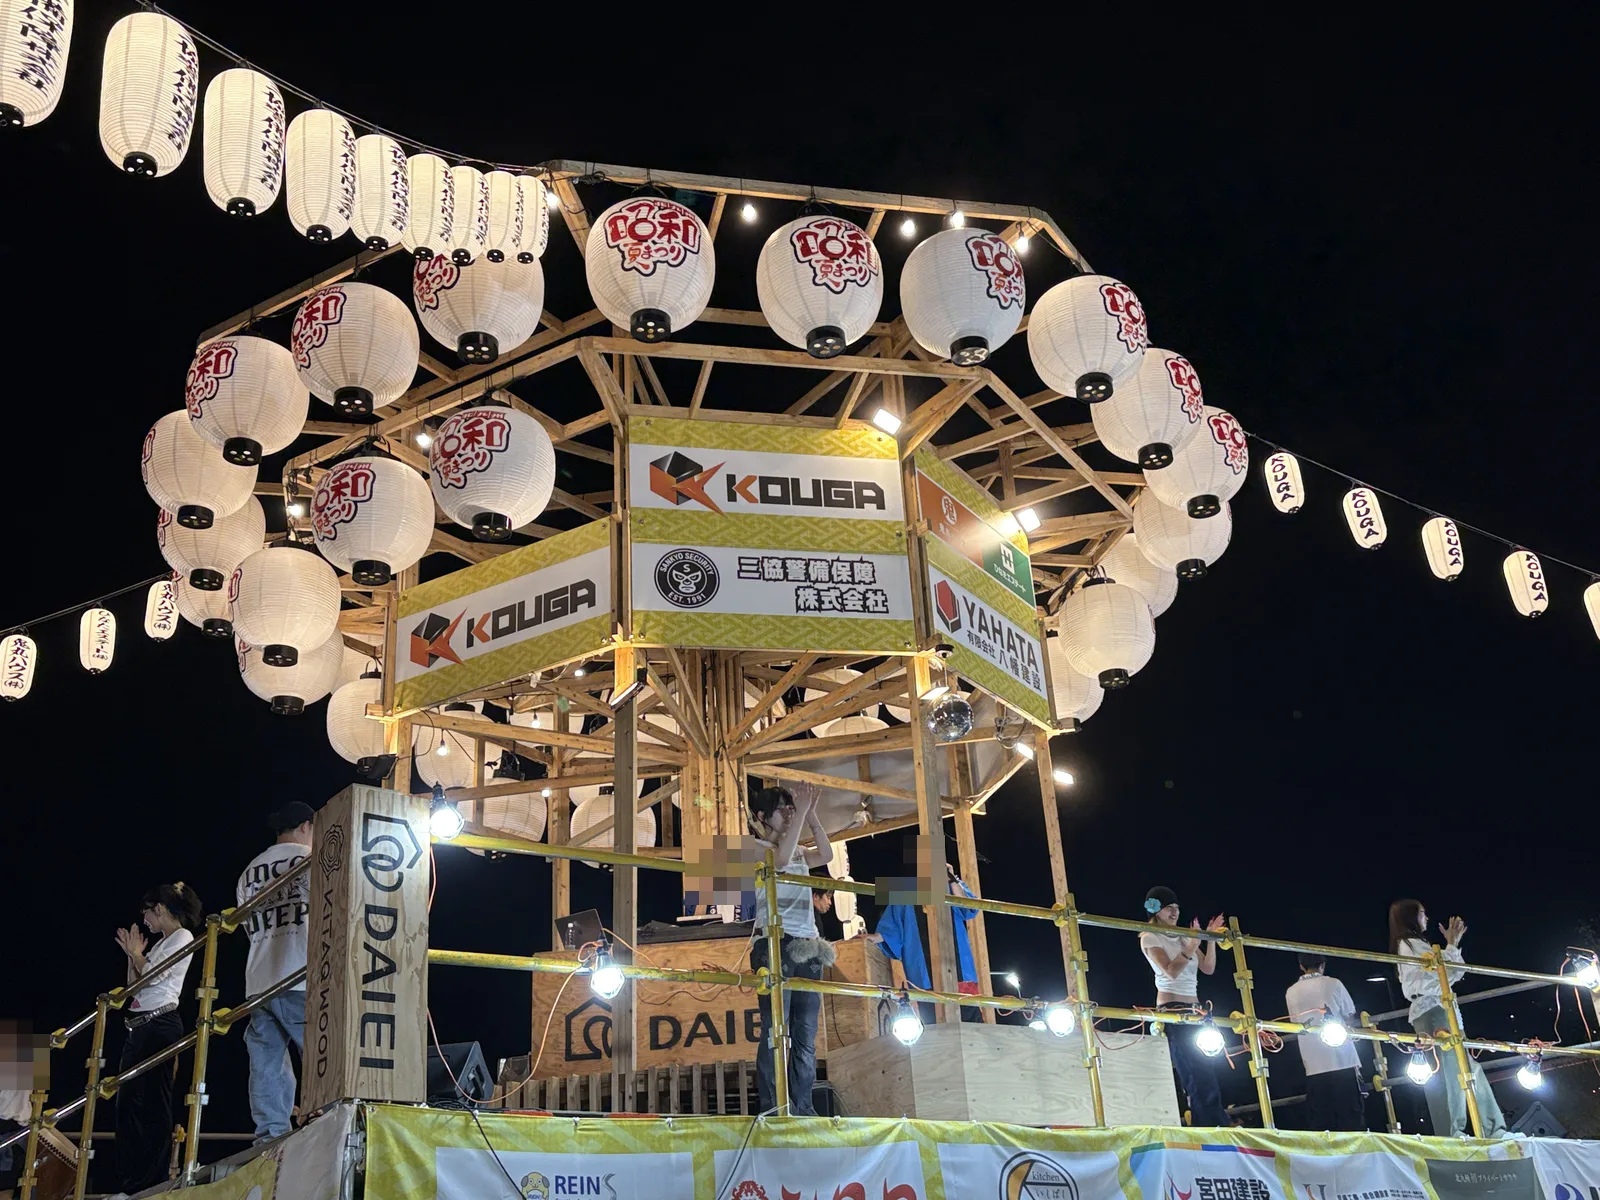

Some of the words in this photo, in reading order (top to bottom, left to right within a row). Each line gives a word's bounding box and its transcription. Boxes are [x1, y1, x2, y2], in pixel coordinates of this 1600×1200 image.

[608, 202, 697, 248] 昭和
[623, 242, 681, 270] 夏まつり
[796, 221, 876, 270] 昭和
[814, 259, 867, 288] 夏まつり
[726, 473, 886, 510] KOUGA
[1271, 456, 1295, 502] KOUGA
[1352, 490, 1379, 539] KOUGA
[1444, 521, 1462, 566] KOUGA
[660, 552, 684, 573] SANKYO
[684, 552, 715, 575] SECURITY
[682, 564, 690, 573] S
[738, 556, 877, 584] 三協警備保障
[1526, 554, 1547, 601] KOUGA
[466, 578, 596, 649] KOUGA
[668, 591, 684, 603] EST.
[687, 593, 706, 604] 1991
[796, 584, 889, 613] 株式会社
[962, 594, 1039, 673] YAHATA
[966, 629, 996, 659] 有限会社
[359, 903, 398, 1070] DAIEI
[651, 1009, 761, 1050] DAIE
[1032, 1171, 1060, 1182] kitchen
[1195, 1176, 1271, 1199] 宮田建設
